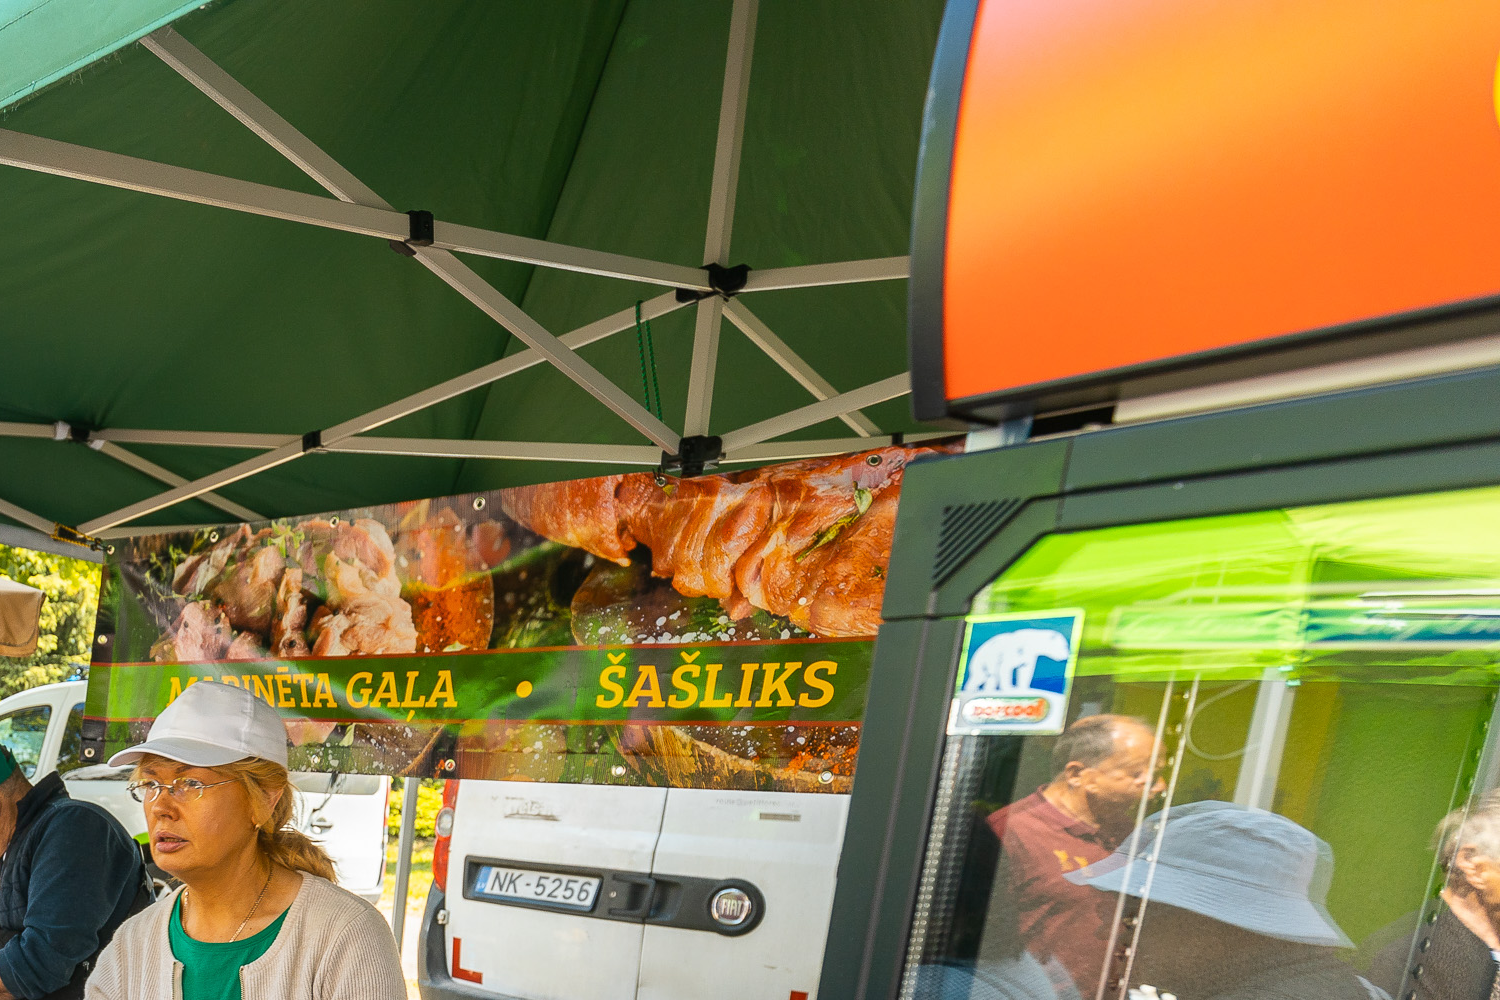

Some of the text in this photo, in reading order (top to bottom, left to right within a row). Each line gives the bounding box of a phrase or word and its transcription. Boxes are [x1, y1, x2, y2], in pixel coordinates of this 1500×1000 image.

[346, 670, 458, 722] GAĻA
[596, 651, 838, 708] ŠAŠLIKS
[721, 898, 743, 917] FIAT
